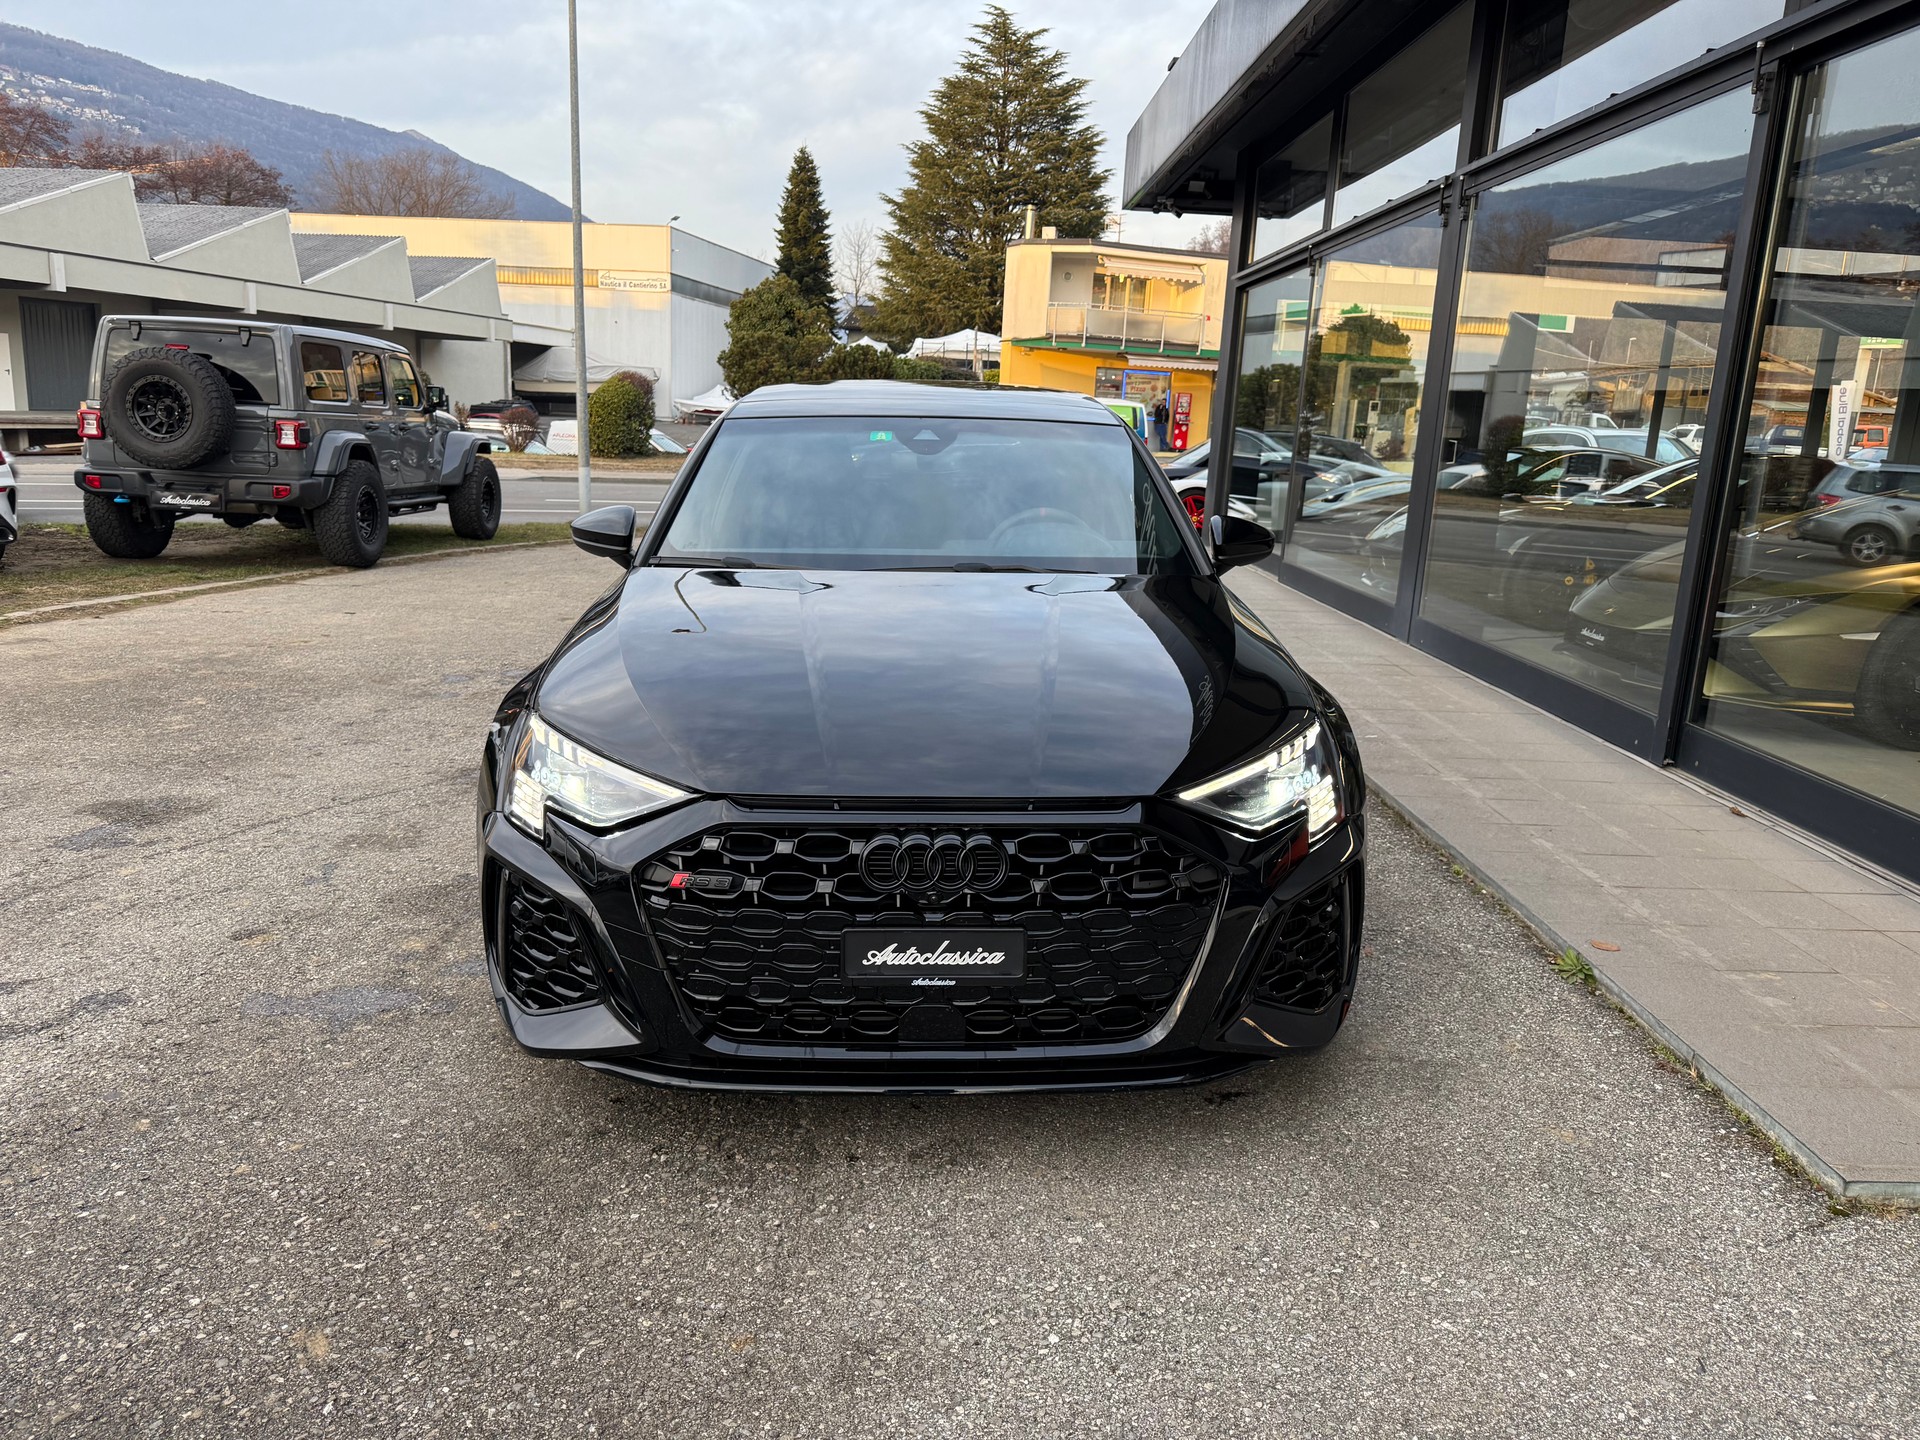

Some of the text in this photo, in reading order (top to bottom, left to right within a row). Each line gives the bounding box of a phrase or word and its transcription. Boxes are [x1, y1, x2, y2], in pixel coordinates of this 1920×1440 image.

[600, 280, 621, 288] Nautica
[629, 281, 658, 289] Cantierino
[160, 494, 211, 506] Autoclassica
[680, 876, 730, 888] RS 3
[862, 940, 1006, 966] Autoclassica
[911, 977, 956, 987] Autoclassica
